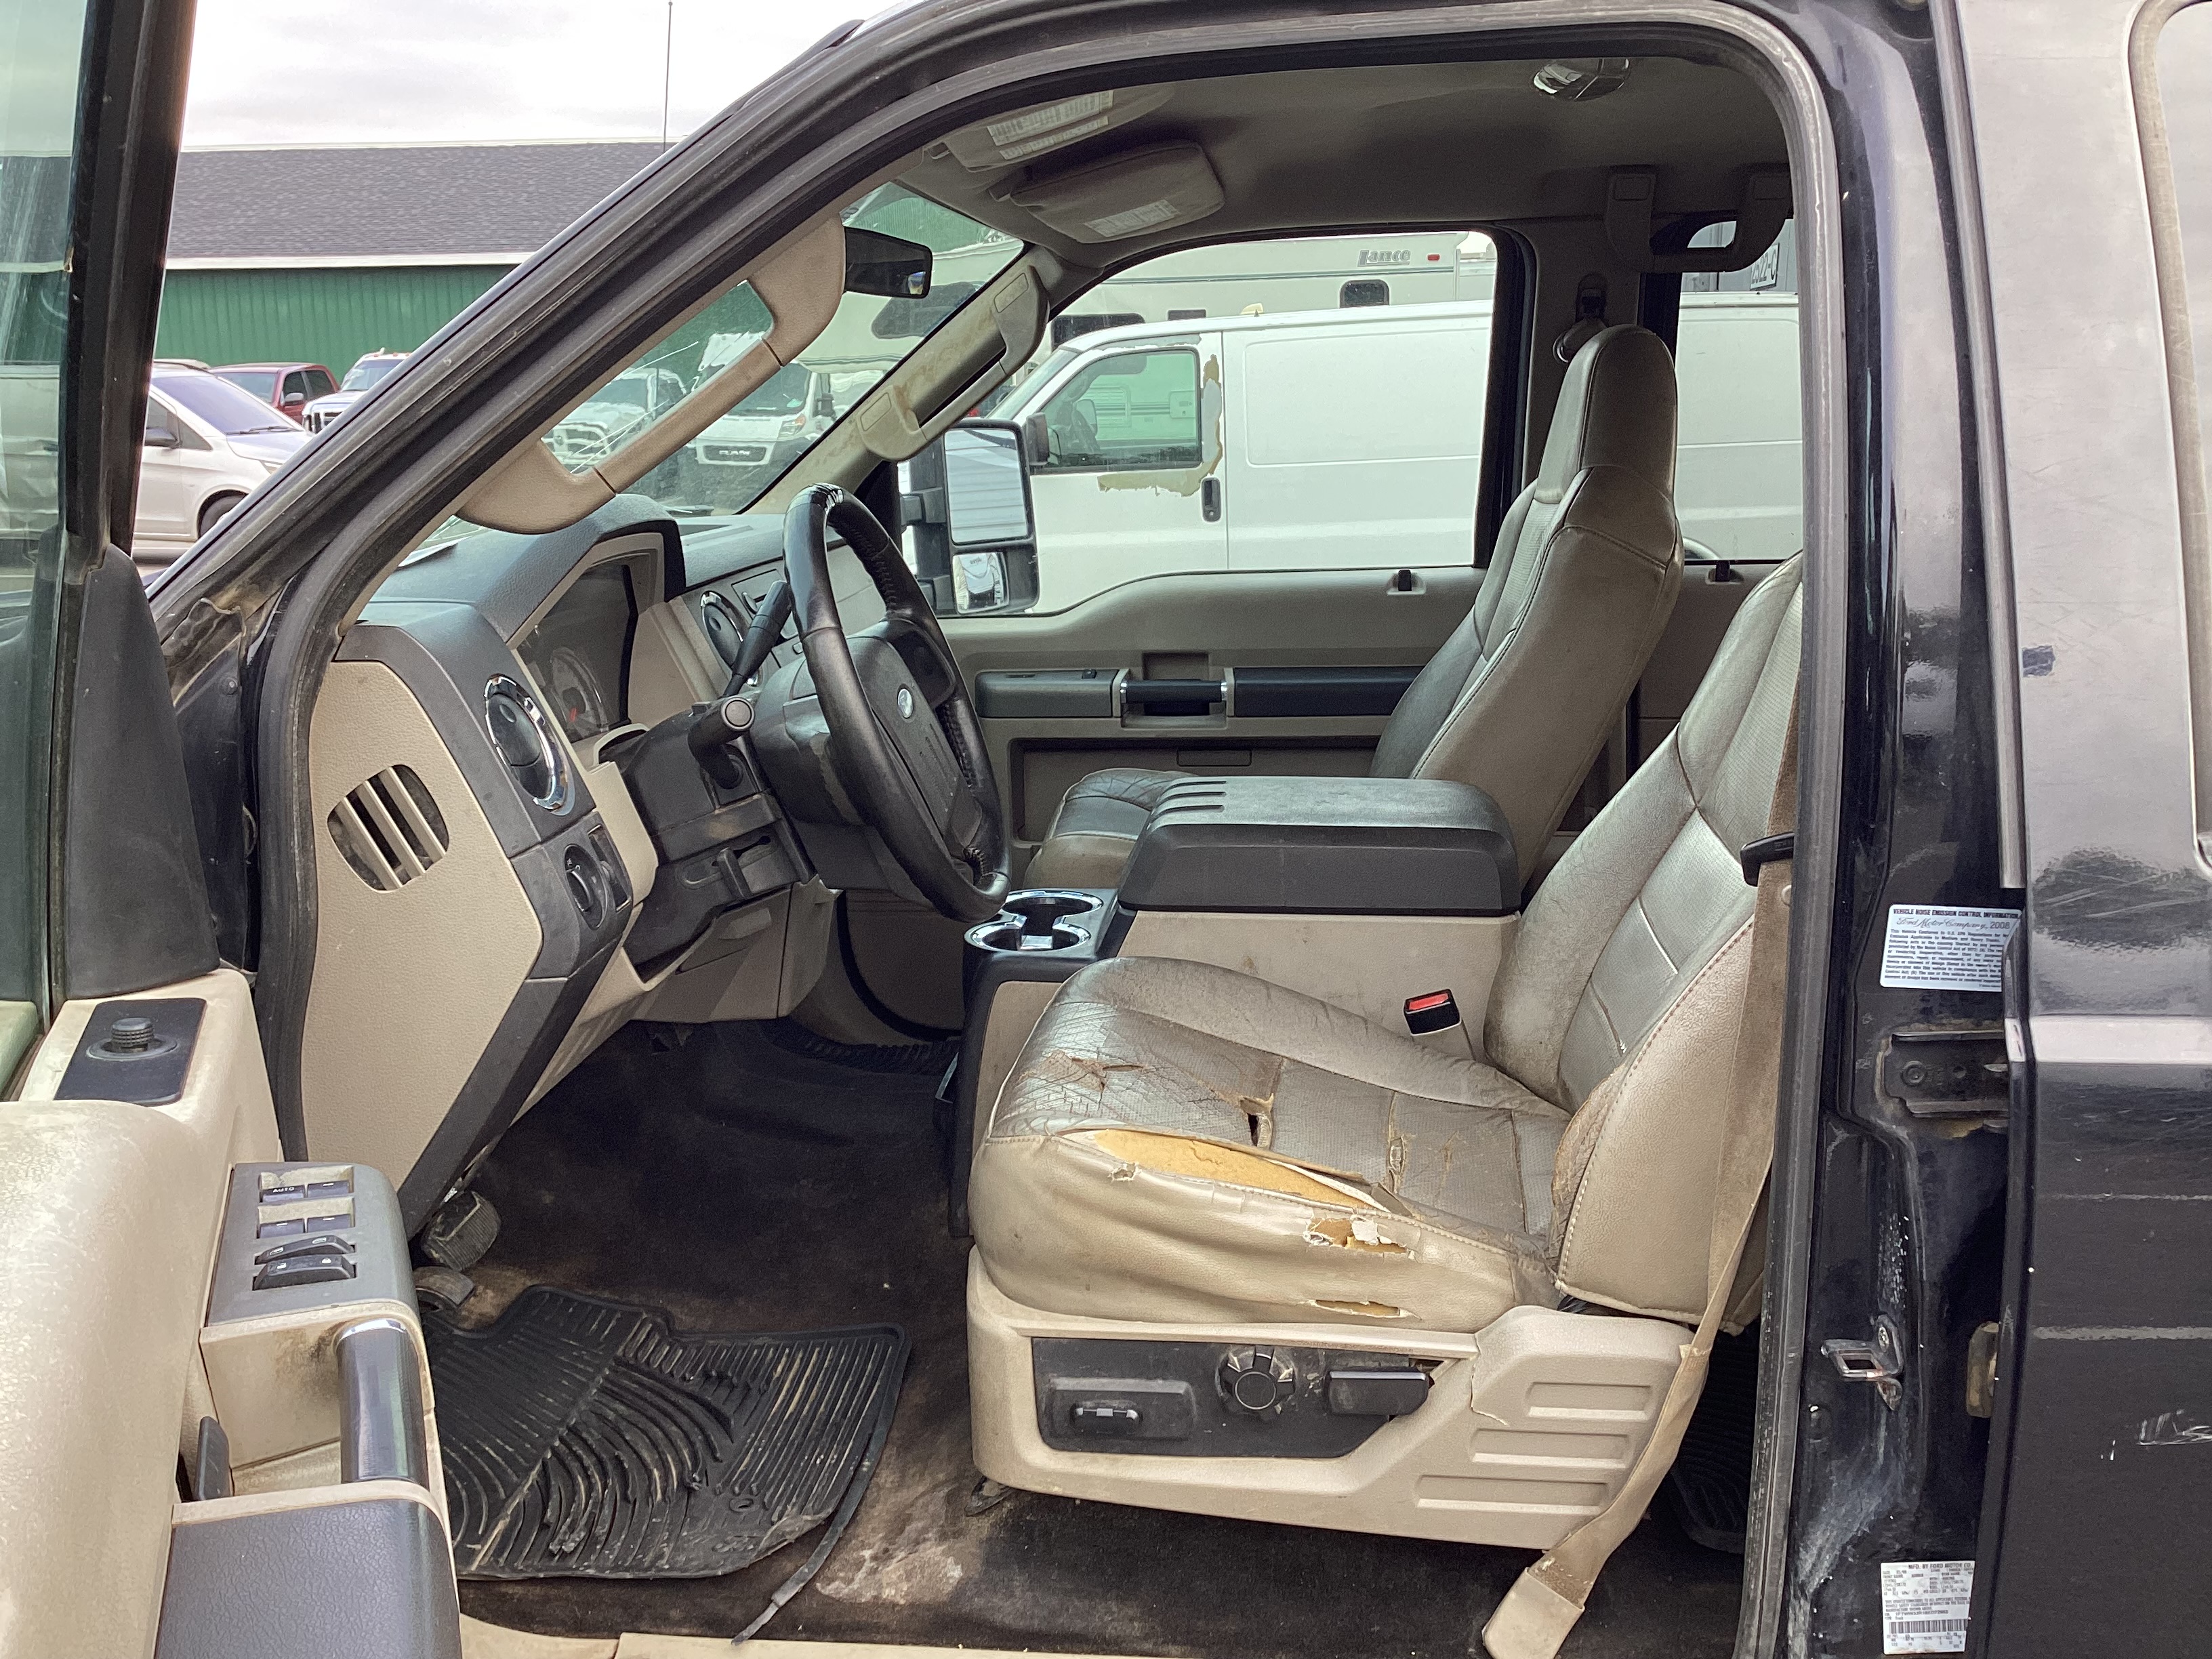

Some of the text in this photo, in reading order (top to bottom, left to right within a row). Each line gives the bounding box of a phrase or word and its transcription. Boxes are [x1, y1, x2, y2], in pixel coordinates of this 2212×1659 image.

[1357, 250, 1411, 267] Lance
[1896, 917, 1918, 926] Ford
[1917, 918, 1944, 928] Motor
[1990, 921, 2011, 929] 2008
